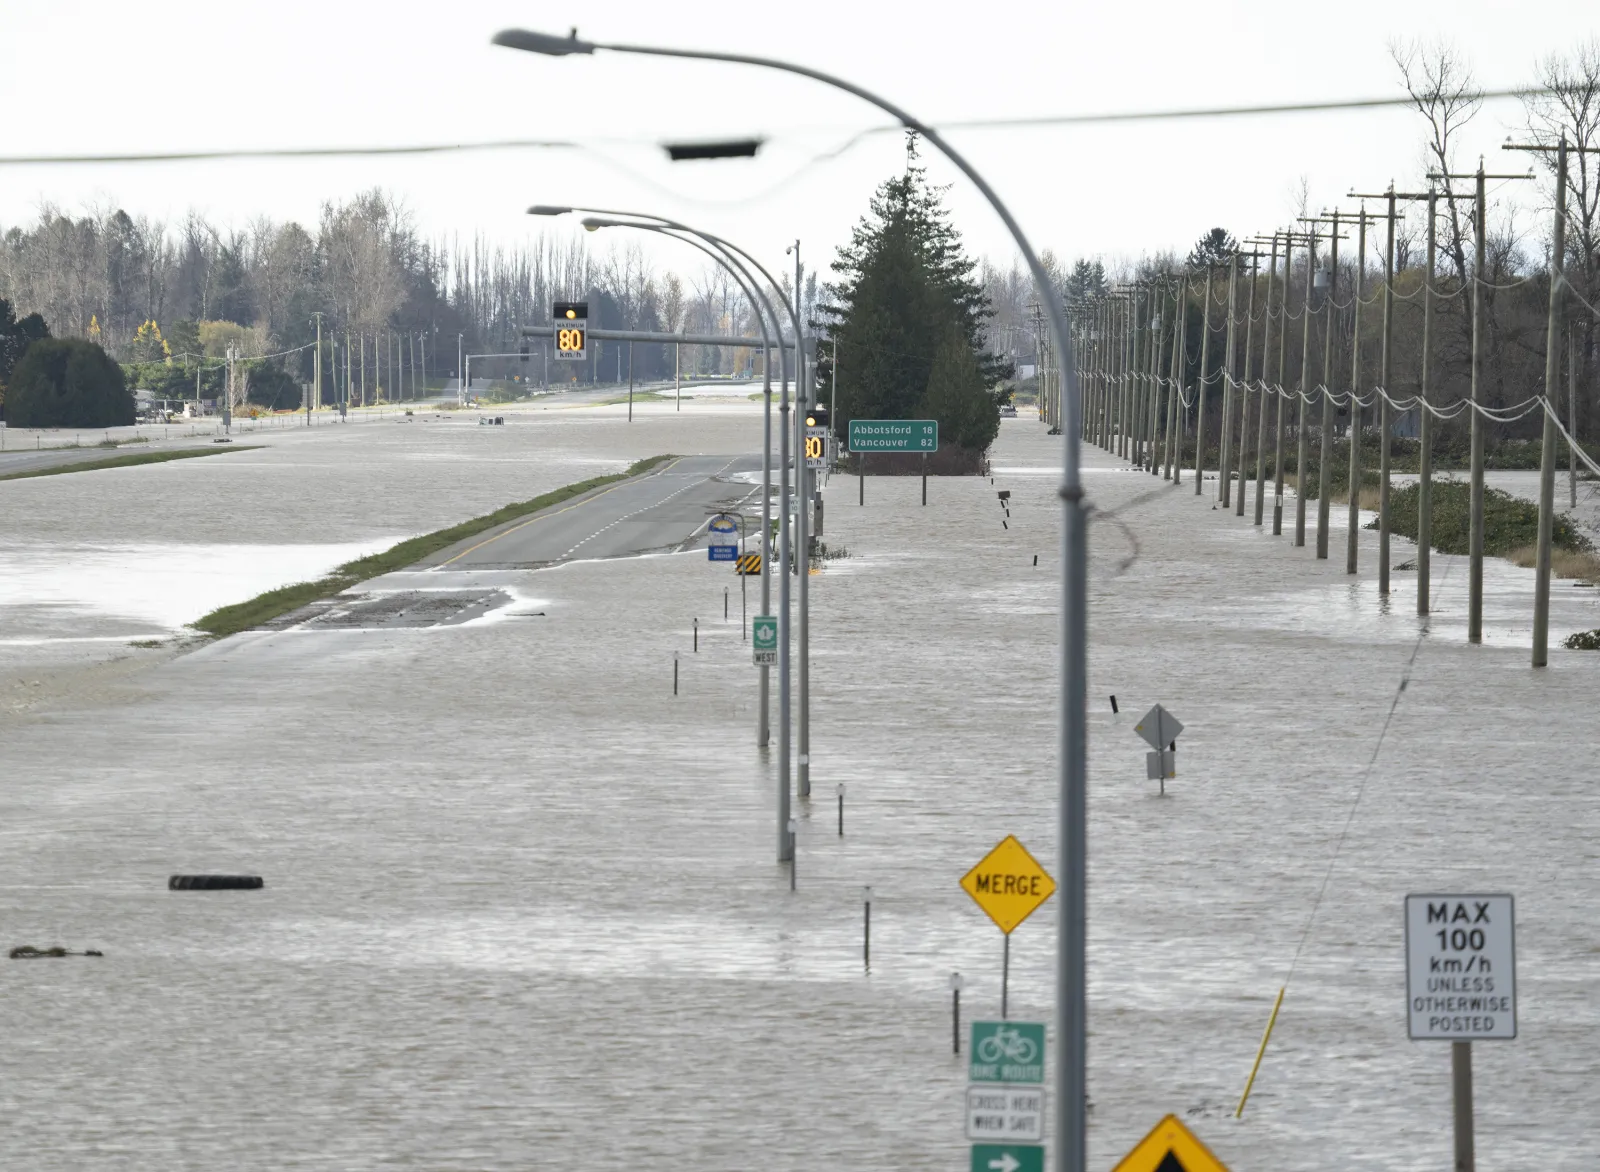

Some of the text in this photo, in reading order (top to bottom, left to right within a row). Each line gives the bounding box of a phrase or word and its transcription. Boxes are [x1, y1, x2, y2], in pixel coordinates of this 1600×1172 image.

[559, 329, 581, 351] 80
[853, 425, 933, 434] Abbotsford 18
[853, 438, 933, 447] Vancouver 82
[755, 652, 776, 663] WEST
[975, 873, 1042, 896] MERGE
[1426, 901, 1491, 924] MAX
[1435, 928, 1486, 952] 100
[1429, 955, 1492, 973] km/h
[1426, 976, 1496, 993] UNLESS
[1412, 996, 1511, 1013] OTHERWISE
[1428, 1015, 1496, 1032] POSTED
